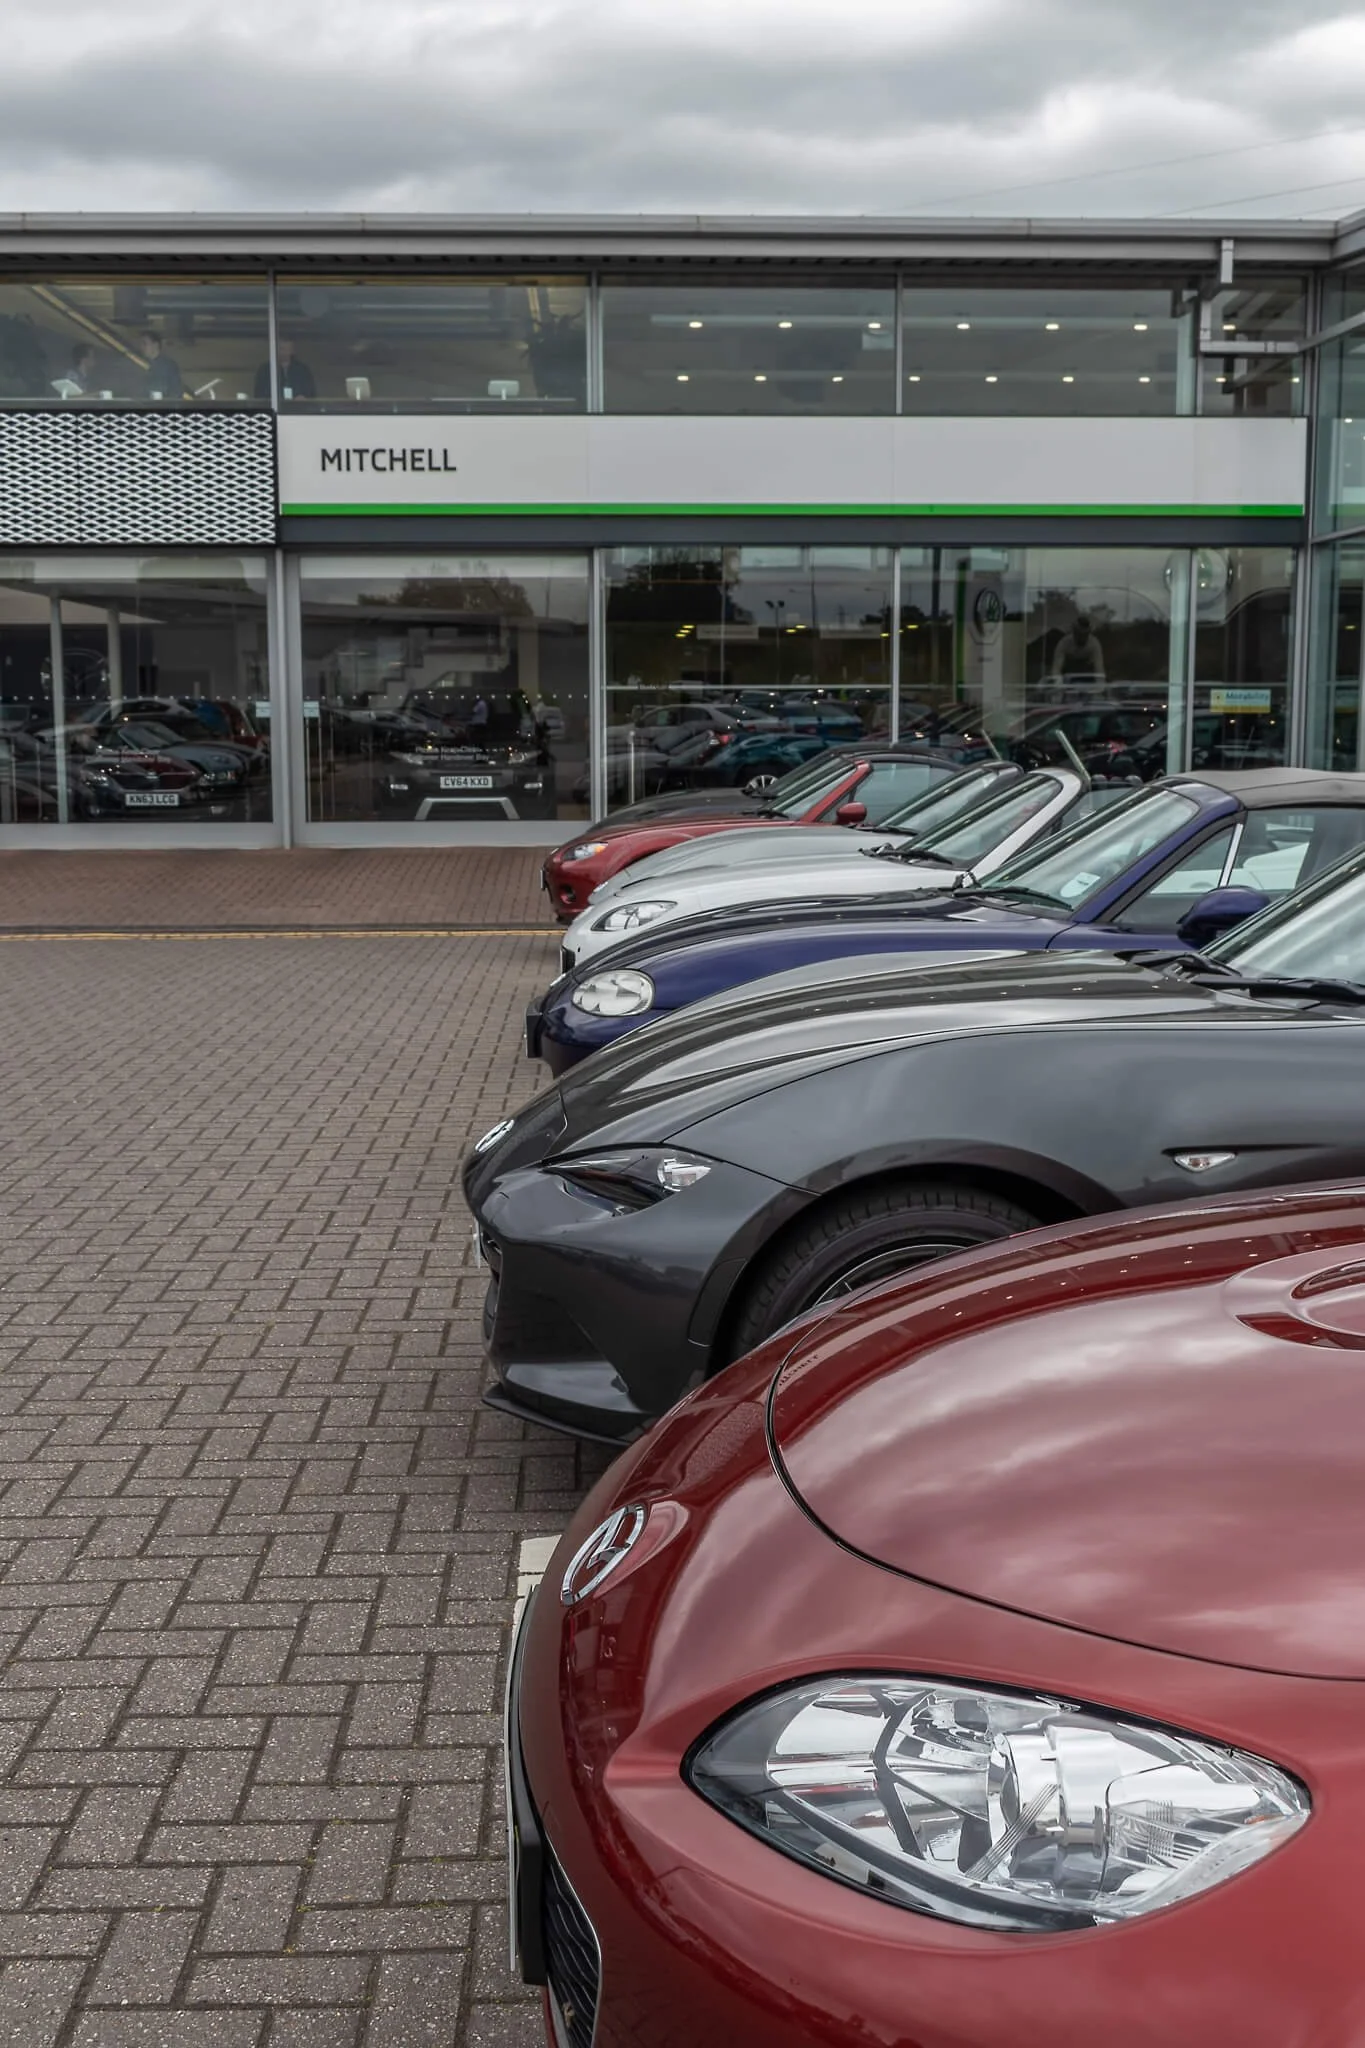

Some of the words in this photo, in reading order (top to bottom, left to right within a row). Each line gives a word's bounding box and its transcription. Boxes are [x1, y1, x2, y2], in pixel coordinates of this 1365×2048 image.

[321, 448, 457, 472] MITCHELL
[444, 776, 468, 787] CV64
[470, 776, 490, 787] KXD
